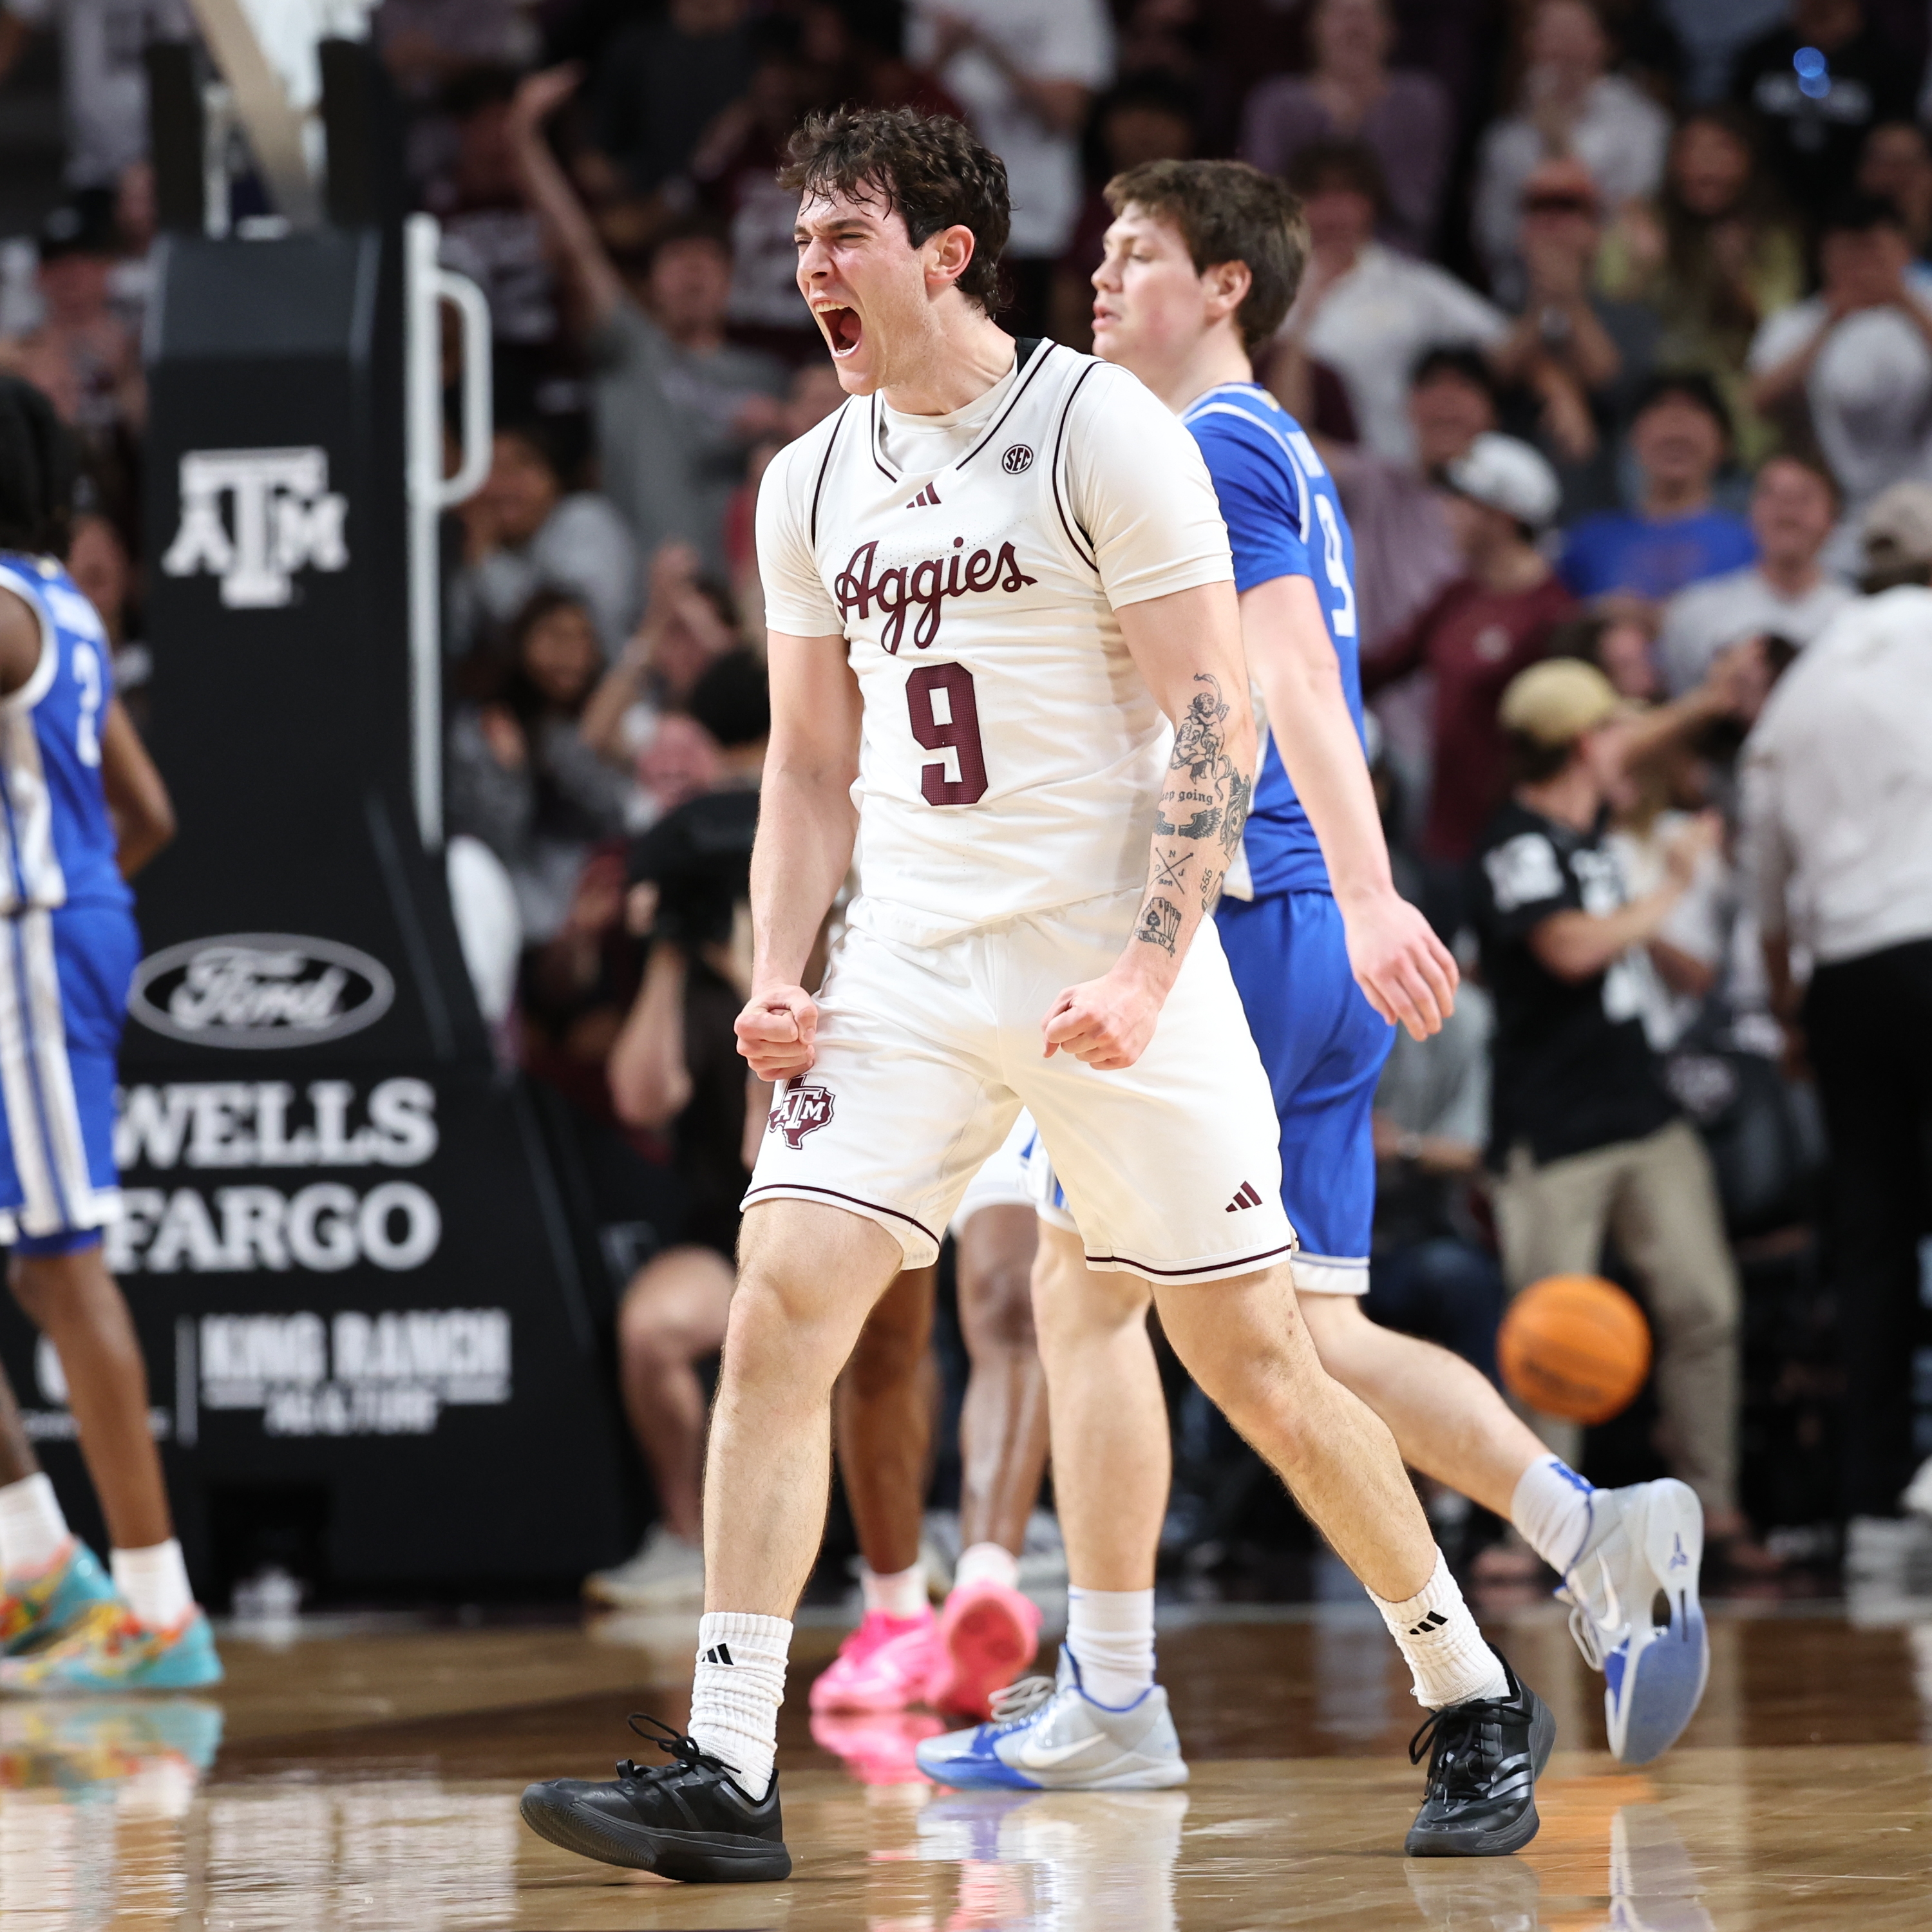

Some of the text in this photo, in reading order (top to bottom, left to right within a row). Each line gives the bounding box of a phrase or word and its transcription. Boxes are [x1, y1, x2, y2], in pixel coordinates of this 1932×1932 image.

[1005, 447, 1031, 471] SEC
[835, 536, 1038, 656] Aggies
[905, 661, 989, 806] 9
[1178, 789, 1213, 805] going
[170, 947, 350, 1030] Ford
[113, 1076, 440, 1170] WELLS
[105, 1180, 442, 1273] FARGO
